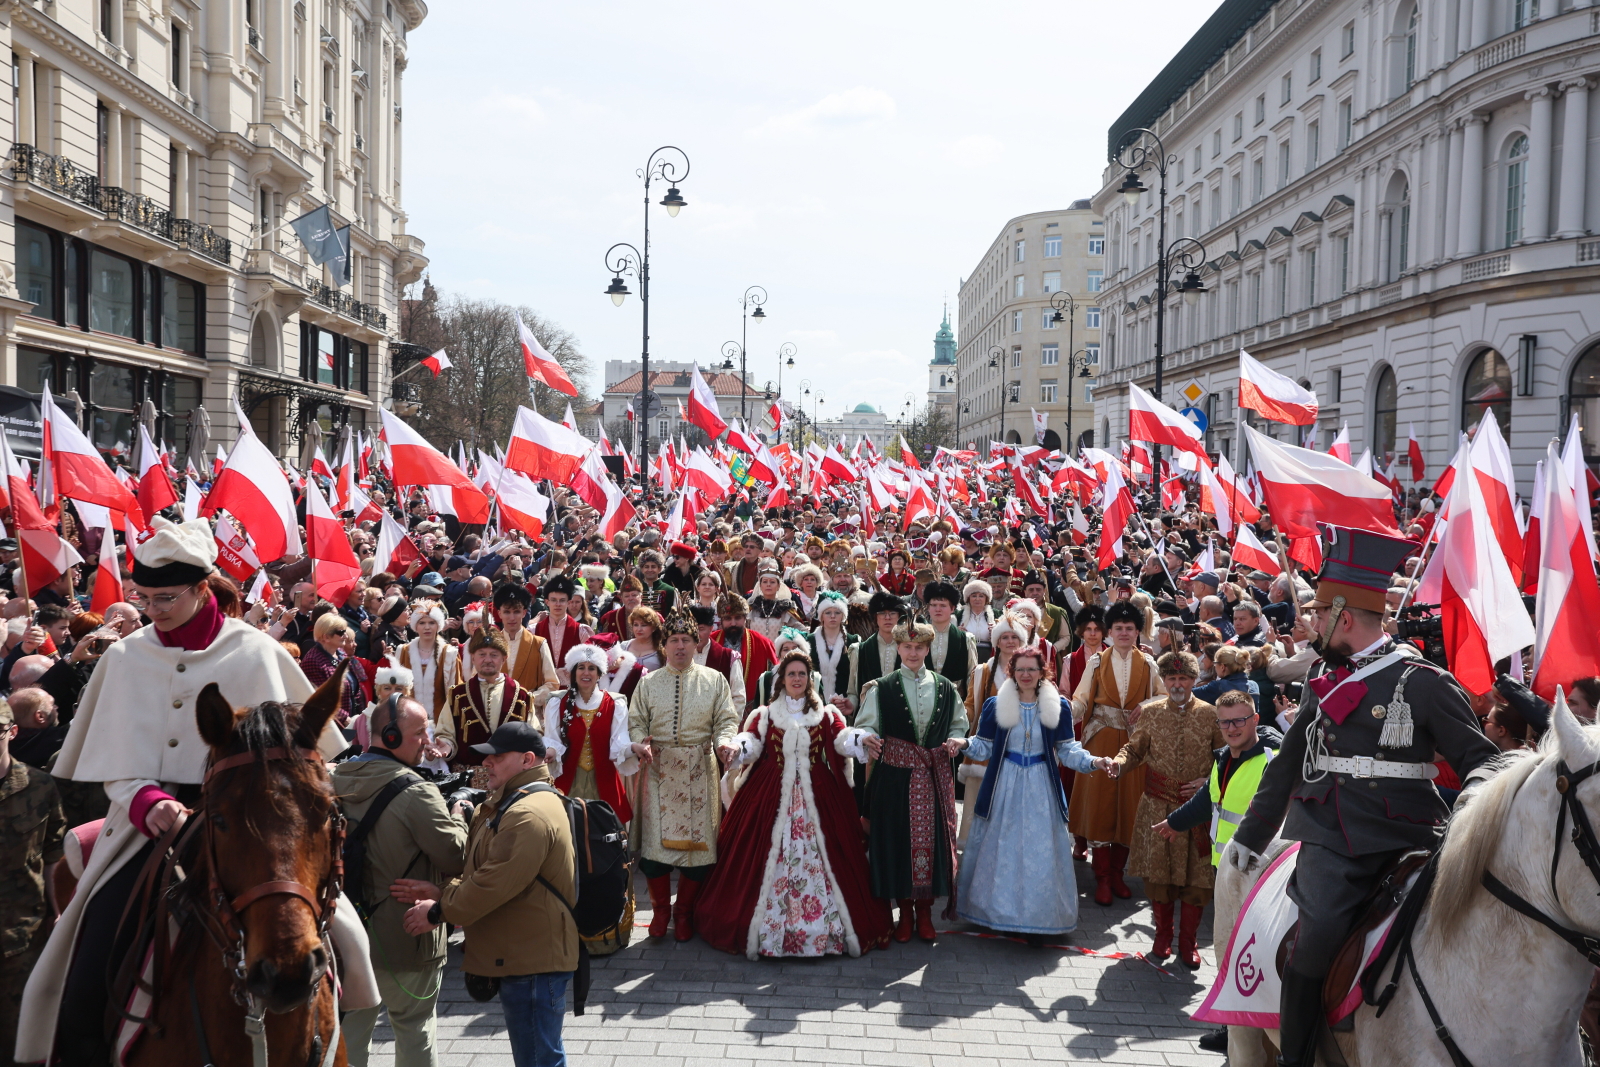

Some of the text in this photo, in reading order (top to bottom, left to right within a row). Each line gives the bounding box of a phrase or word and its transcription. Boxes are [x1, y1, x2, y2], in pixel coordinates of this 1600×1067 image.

[9, 416, 34, 427] Niemiec
[18, 430, 42, 439] germani
[220, 546, 242, 568] POLSKA
[1240, 952, 1256, 988] 22
